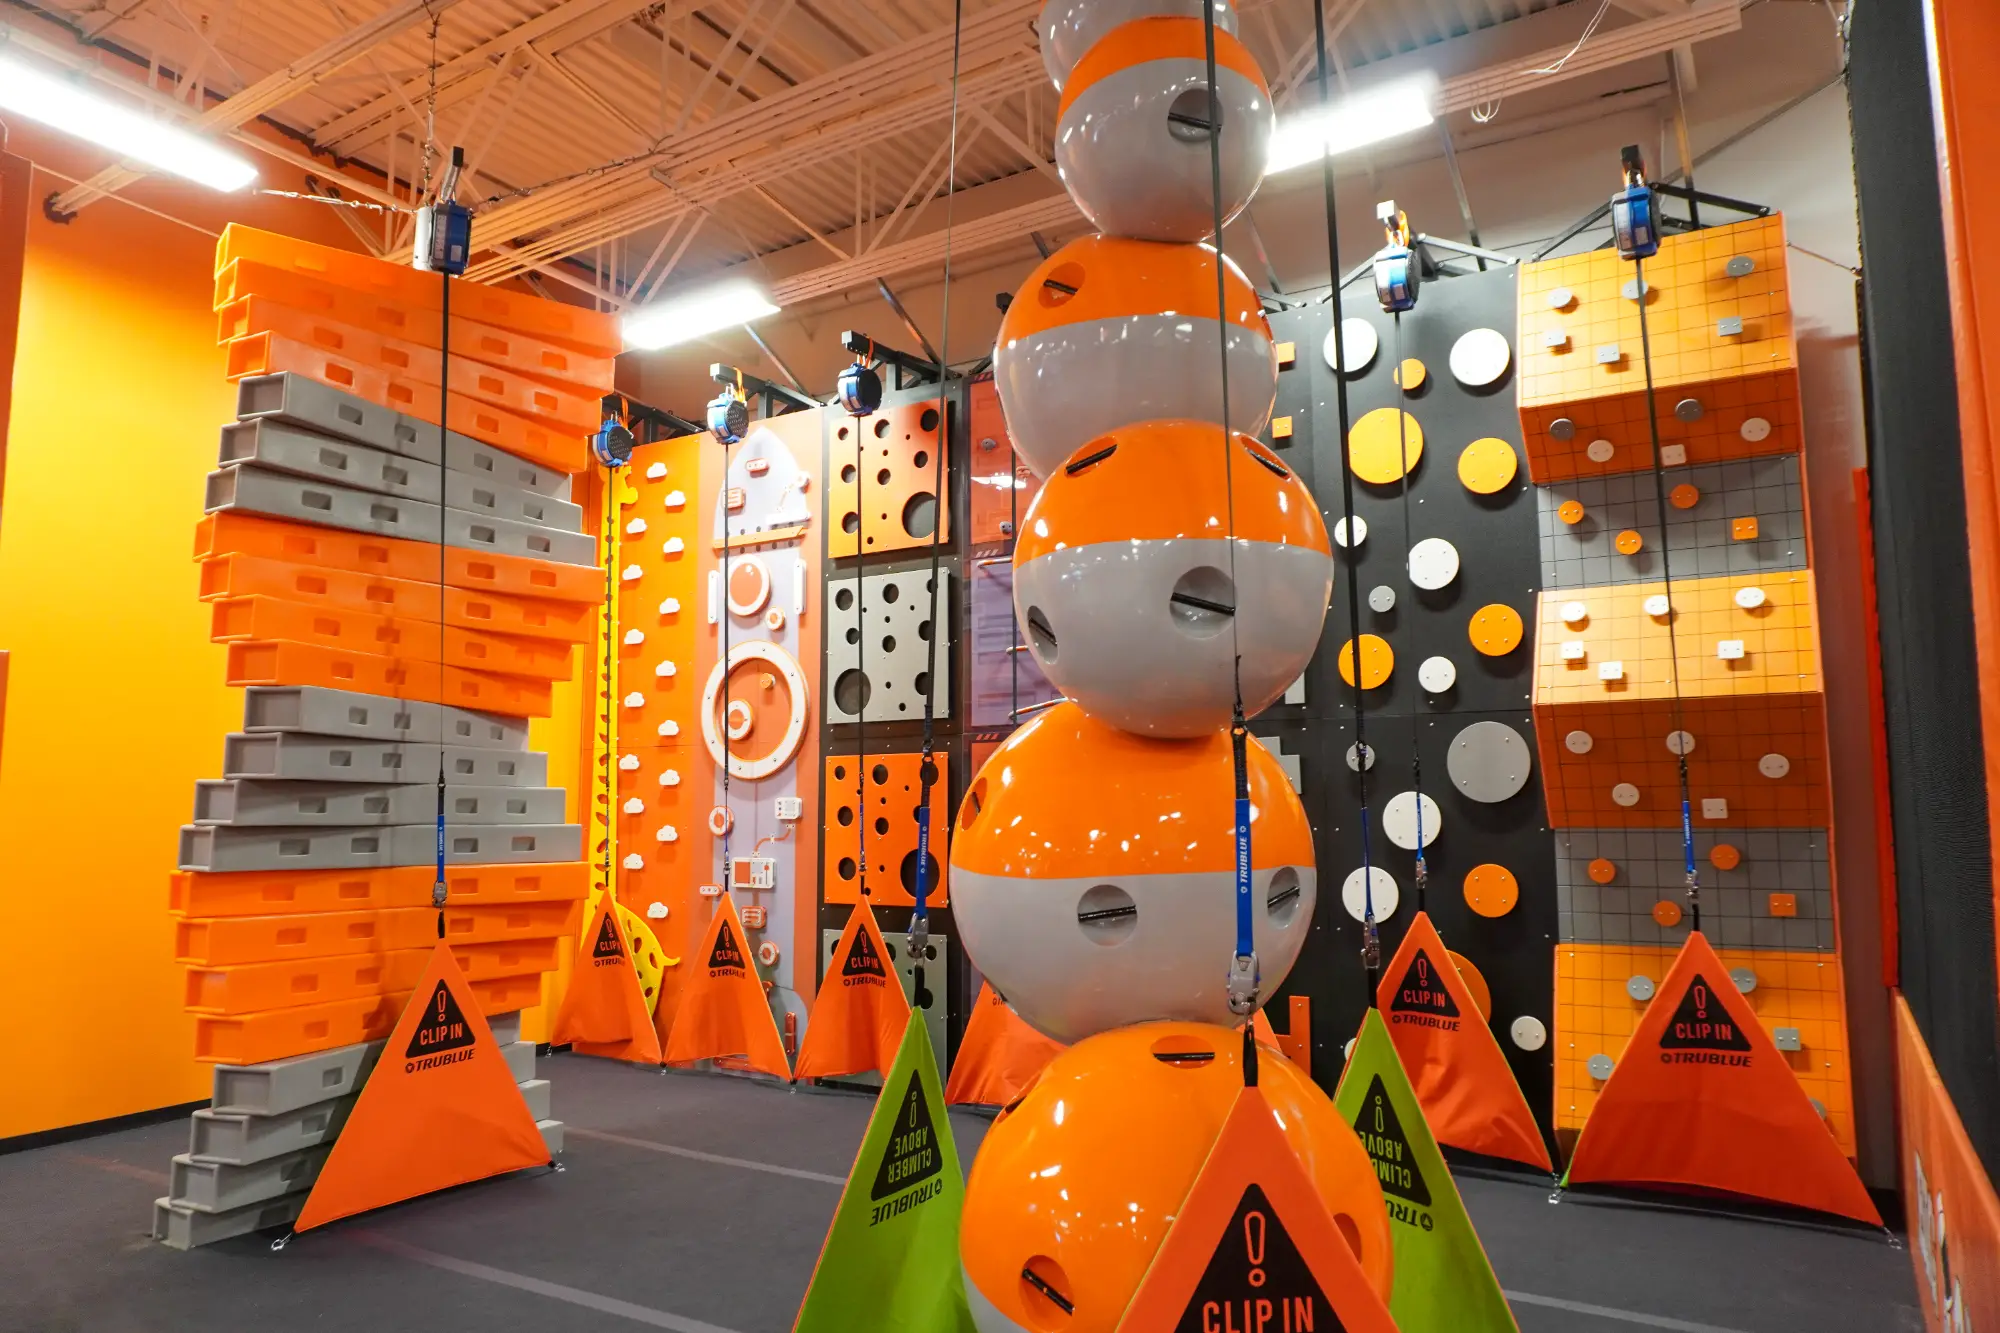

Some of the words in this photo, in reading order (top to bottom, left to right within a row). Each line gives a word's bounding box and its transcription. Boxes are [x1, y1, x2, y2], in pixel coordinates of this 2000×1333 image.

[1239, 836, 1248, 883] TRUBLUE
[599, 940, 617, 951] CLIP
[851, 956, 870, 968] CLIP
[1403, 989, 1430, 1004] CLIP
[1432, 991, 1446, 1008] IN
[1402, 1013, 1460, 1031] TRUBLUE
[1675, 1023, 1711, 1039] CLIP
[1715, 1023, 1732, 1040] IN
[420, 1026, 447, 1046] CLIP
[450, 1023, 463, 1039] IN
[416, 1048, 476, 1072] TRUBLUE
[1674, 1052, 1754, 1068] TRUBLUE
[894, 1126, 928, 1157] ABOVE
[1359, 1131, 1402, 1161] ABOVE
[888, 1148, 932, 1184] CLIMBER
[1371, 1159, 1411, 1188] CLIMB
[869, 1185, 934, 1227] TRUBLUE
[1203, 1299, 1273, 1333] CLIP
[1283, 1296, 1314, 1333] IN
